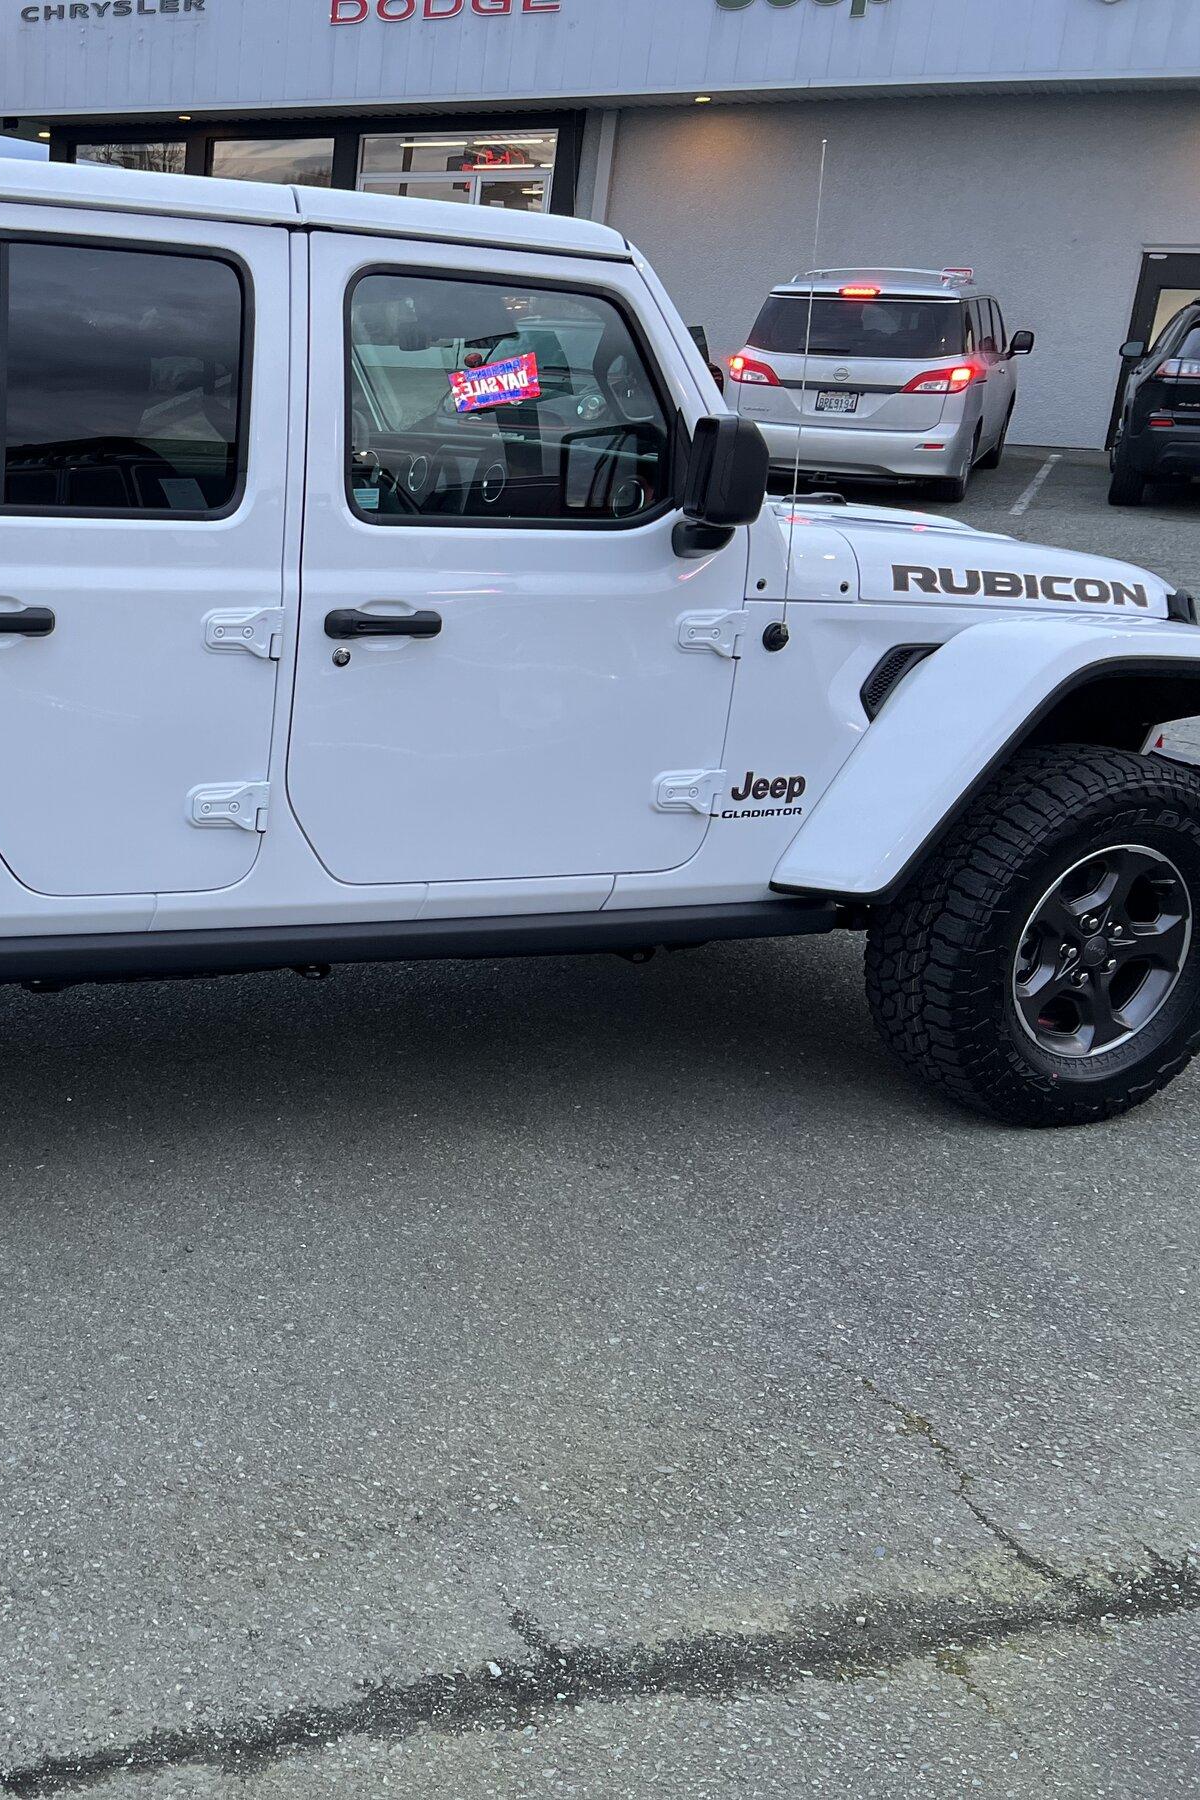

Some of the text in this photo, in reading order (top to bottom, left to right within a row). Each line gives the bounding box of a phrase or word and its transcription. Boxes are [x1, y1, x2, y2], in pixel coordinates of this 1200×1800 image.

[20, 0, 205, 23] CHRYSLER
[891, 564, 1149, 607] RUBICON
[731, 771, 806, 804] Jeep
[721, 807, 803, 819] GLADIATOR
